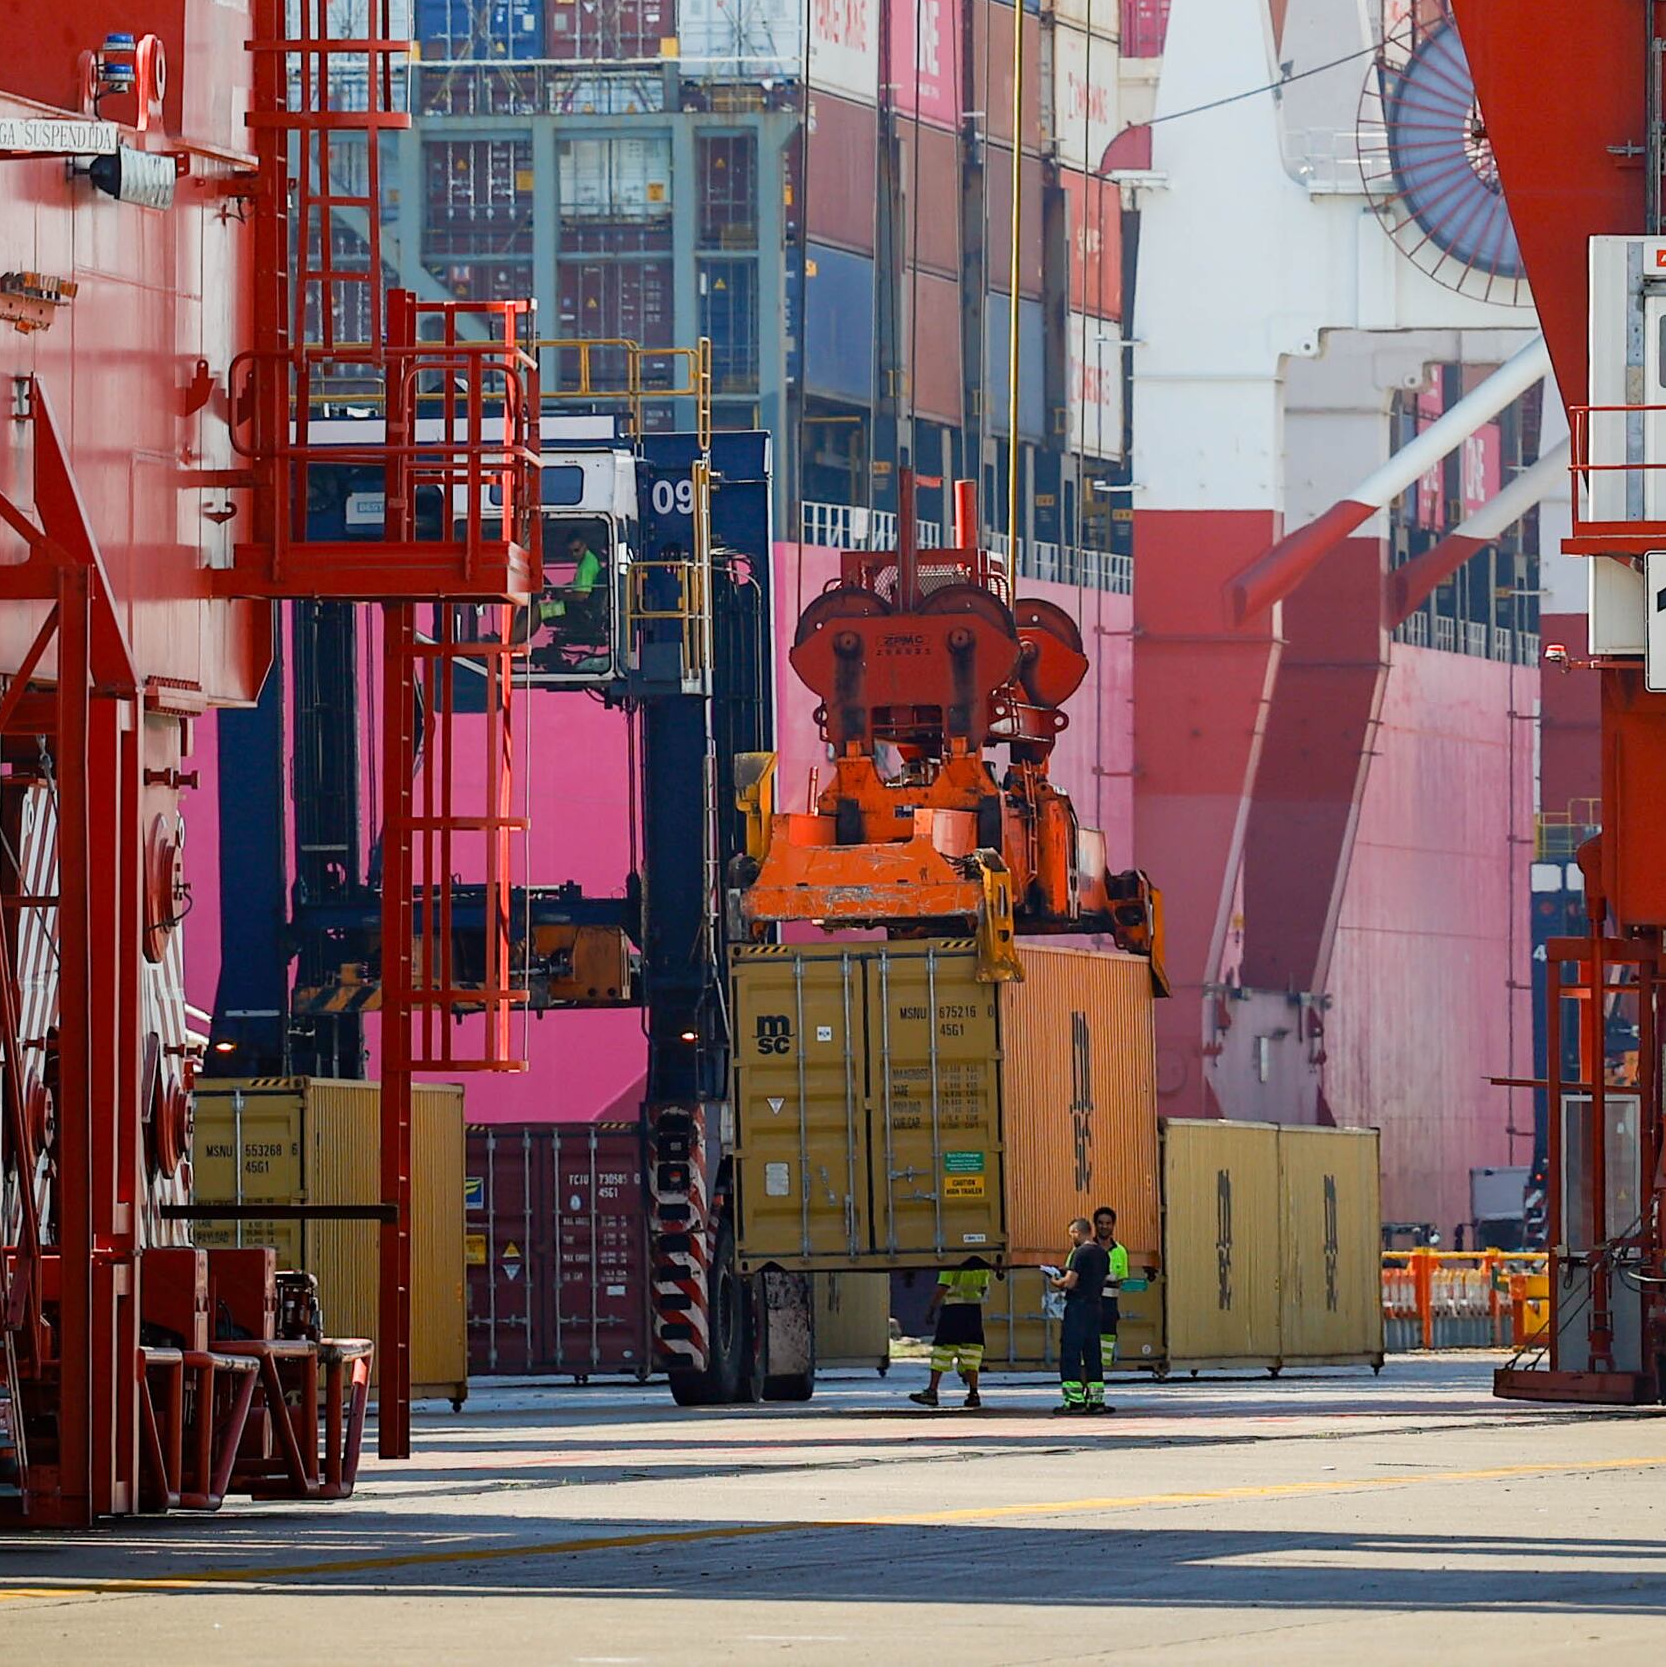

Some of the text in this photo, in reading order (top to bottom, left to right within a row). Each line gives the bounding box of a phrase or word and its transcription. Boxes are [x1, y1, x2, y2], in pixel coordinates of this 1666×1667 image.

[23, 121, 113, 150] SUSPENDIDA
[651, 479, 694, 515] 09
[900, 1007, 927, 1020] MSNU
[939, 1005, 977, 1019] 675216
[940, 1024, 964, 1036] 45G1
[205, 1143, 299, 1157] MSNU 553268 6
[245, 1161, 269, 1173] 45G1
